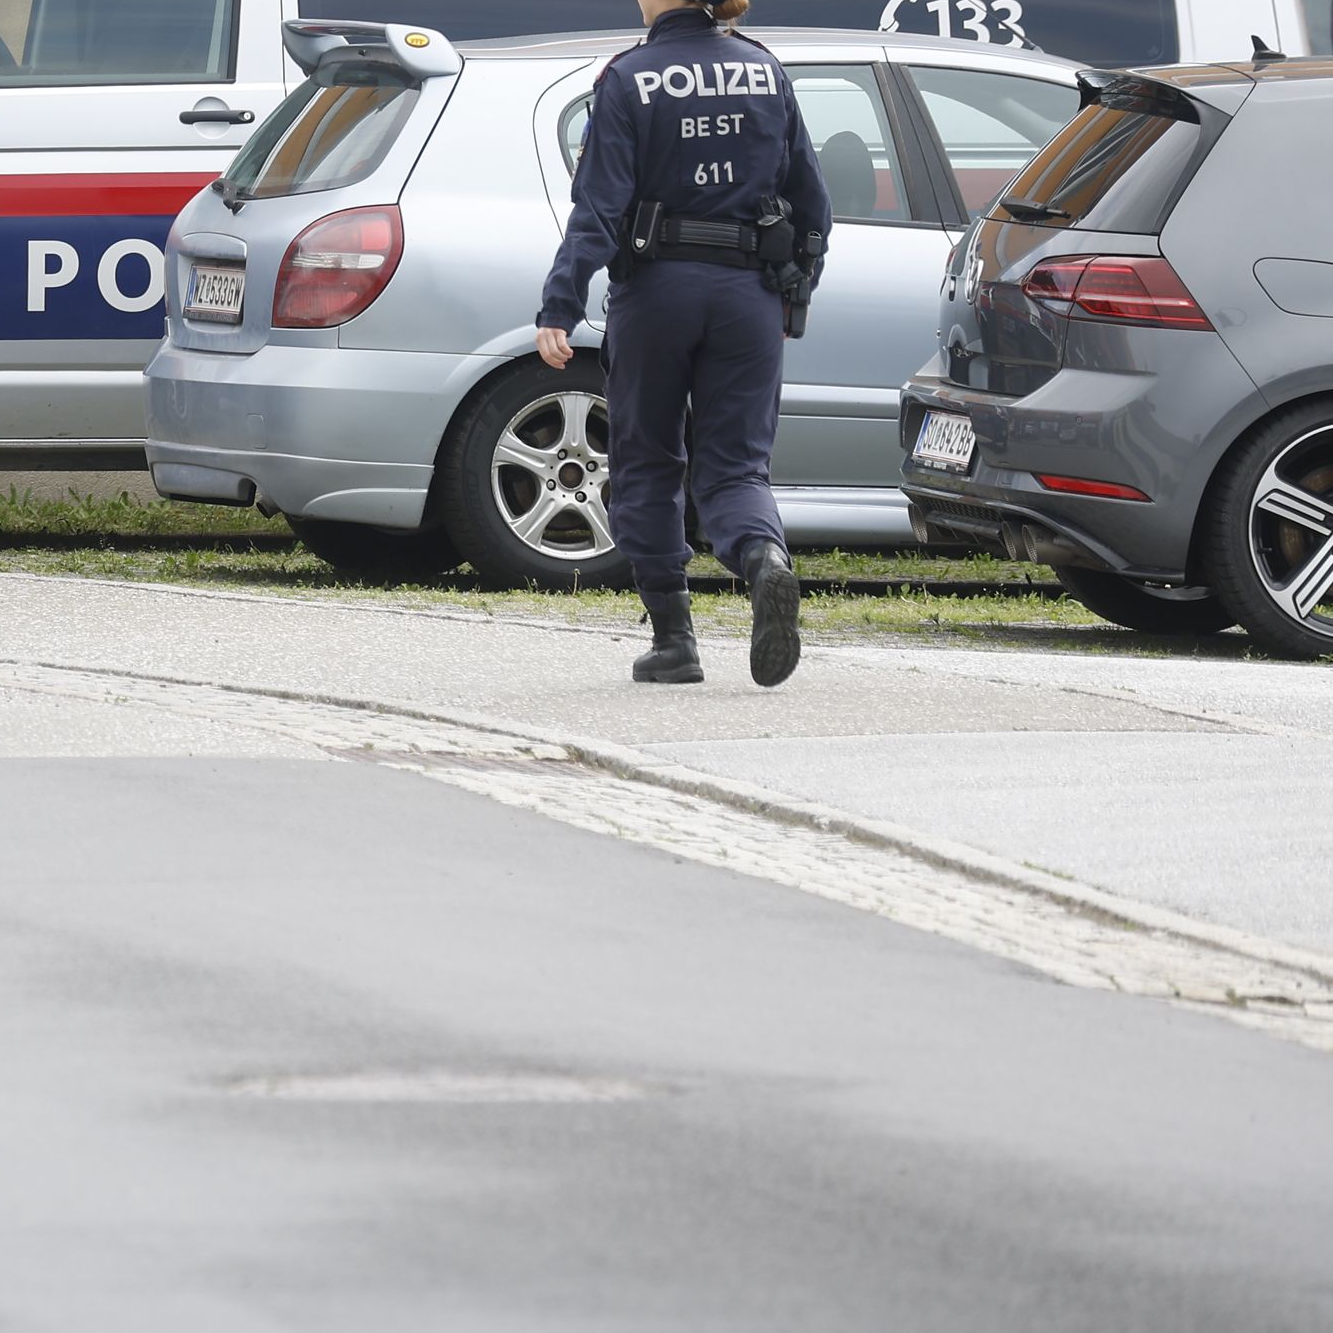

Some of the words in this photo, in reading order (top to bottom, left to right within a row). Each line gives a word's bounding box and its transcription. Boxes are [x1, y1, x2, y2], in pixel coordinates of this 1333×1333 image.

[634, 62, 778, 104] POLIZEI
[694, 161, 734, 186] 611
[27, 238, 167, 313] PO
